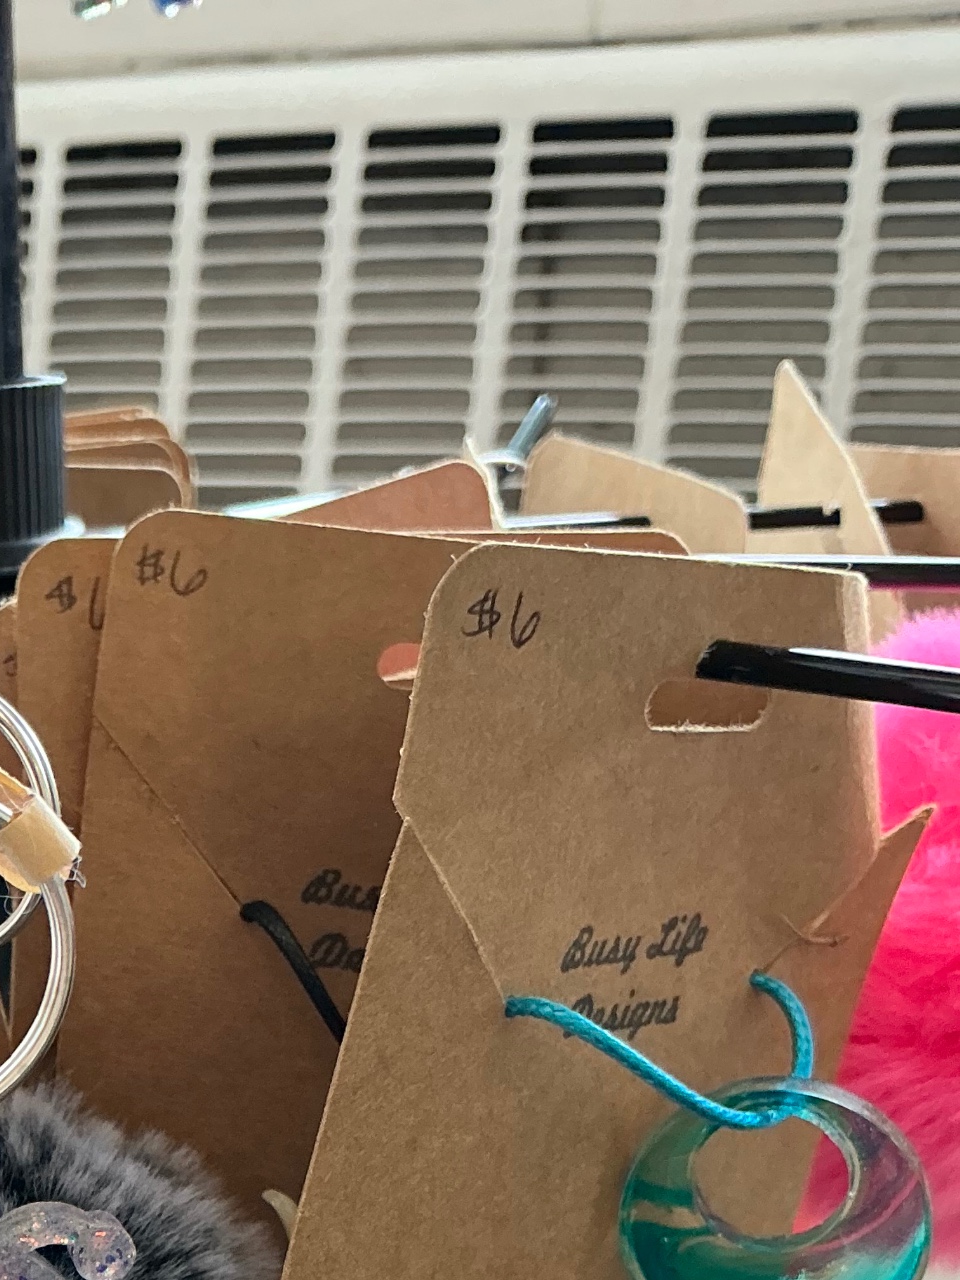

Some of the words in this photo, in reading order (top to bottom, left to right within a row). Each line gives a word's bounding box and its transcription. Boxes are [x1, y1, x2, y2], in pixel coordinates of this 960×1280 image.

[136, 544, 209, 598] $6
[460, 587, 541, 650] $6
[301, 868, 382, 912] Bus
[560, 924, 642, 976] Busy
[645, 912, 709, 968] Life
